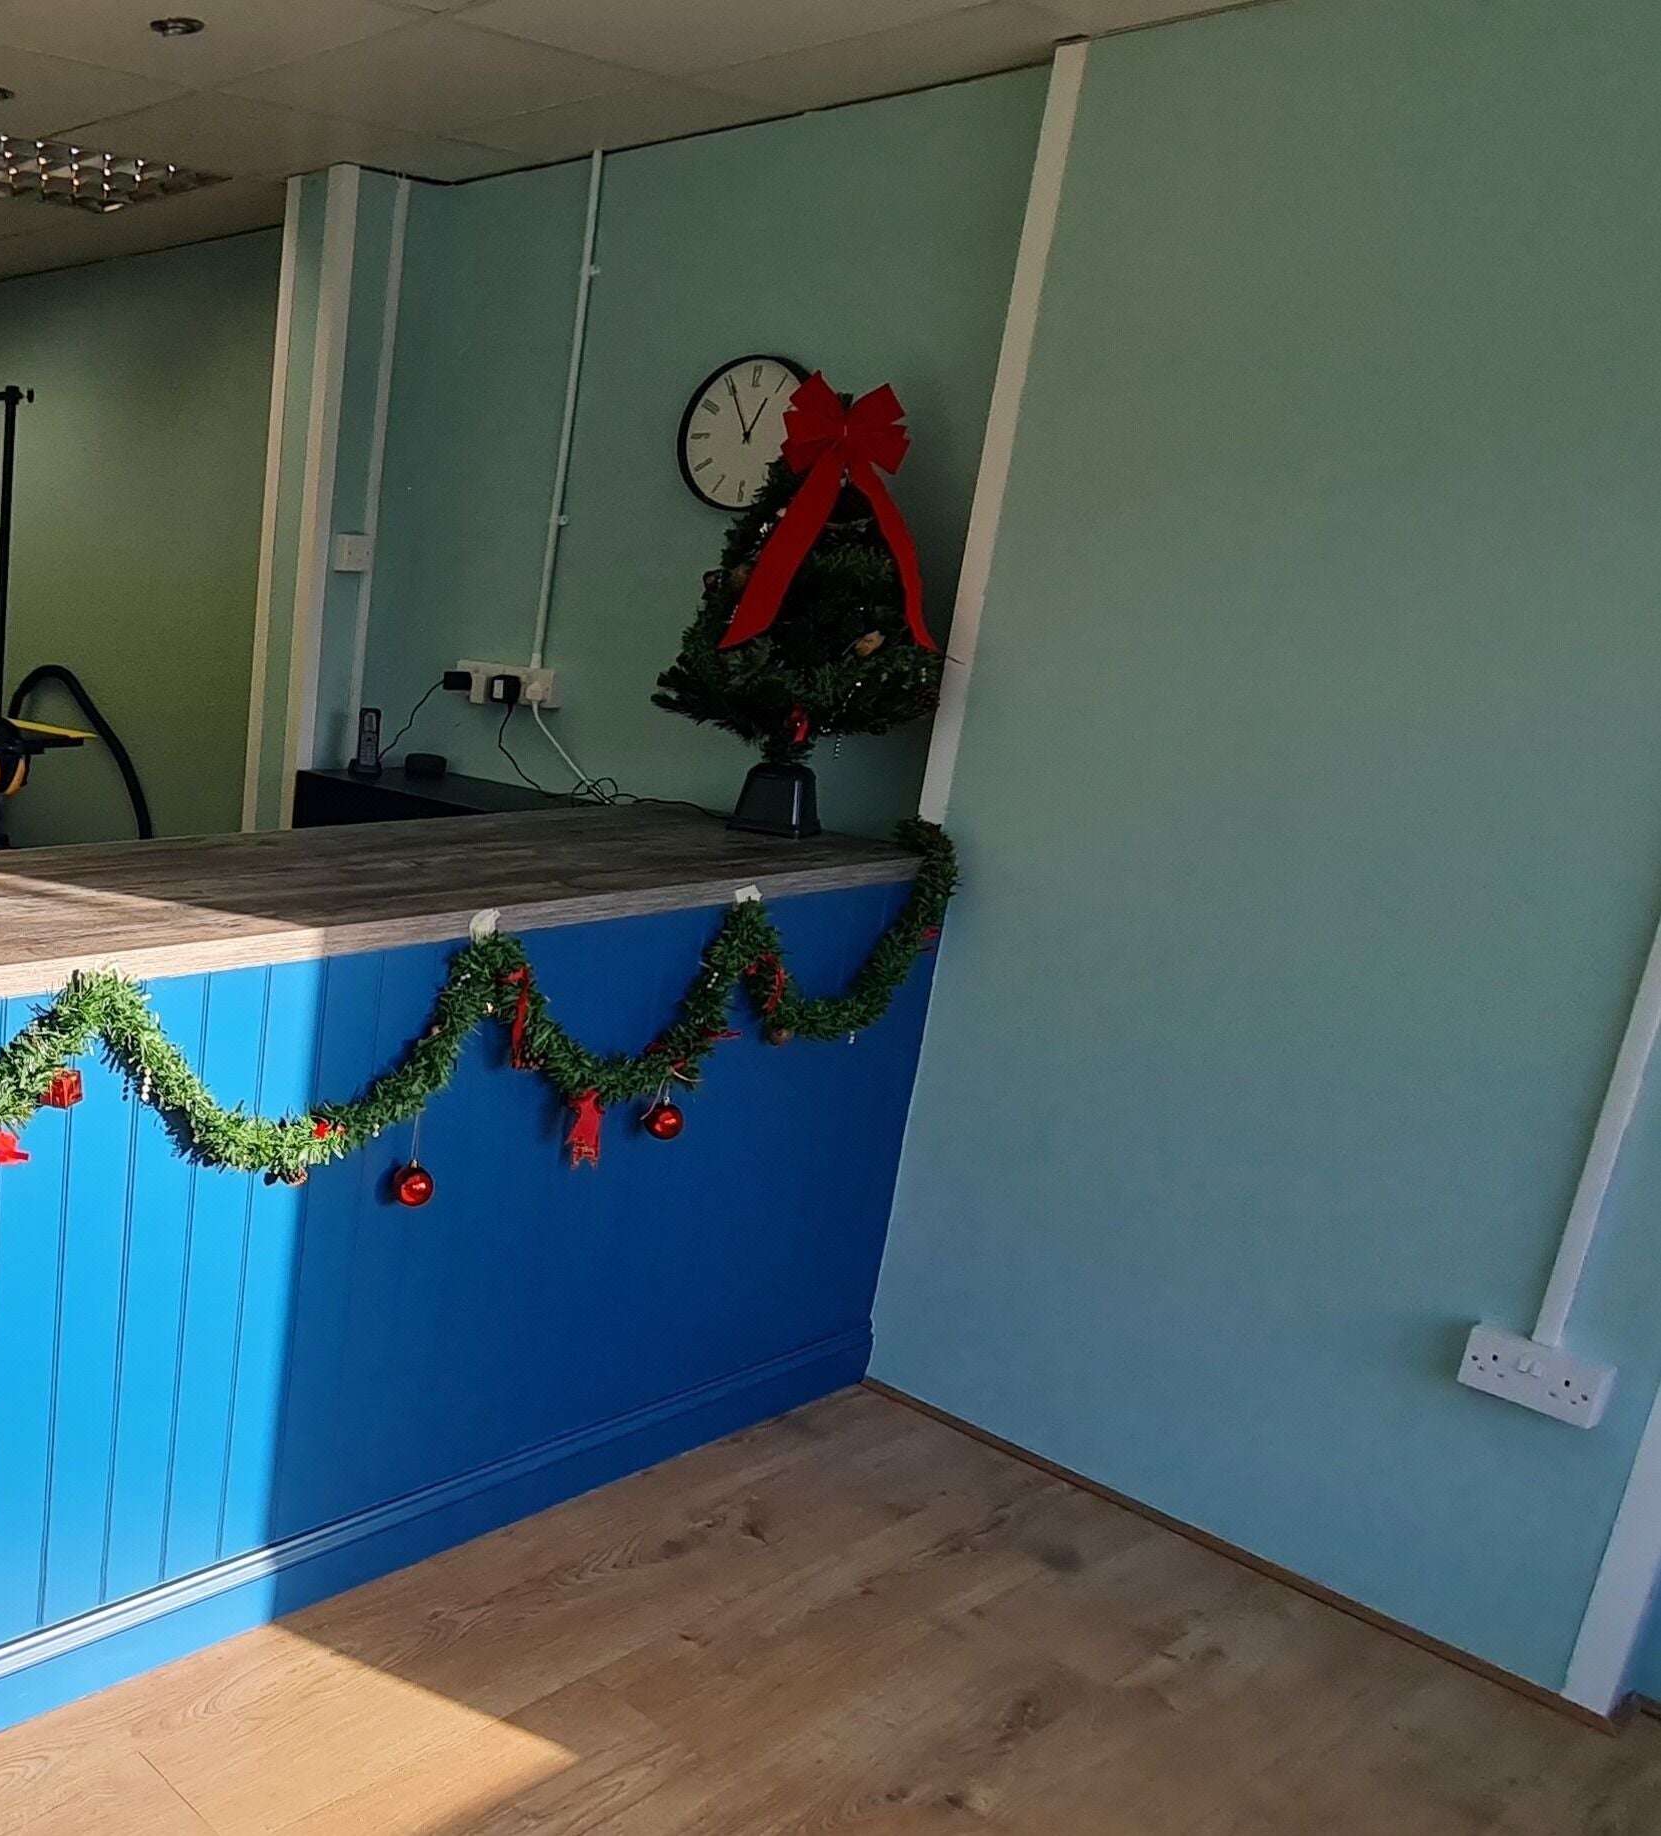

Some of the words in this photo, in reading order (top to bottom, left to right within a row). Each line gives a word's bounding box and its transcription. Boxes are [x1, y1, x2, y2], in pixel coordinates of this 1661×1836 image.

[752, 365, 764, 388] 12
[775, 373, 788, 394] 1
[701, 399, 720, 416] 10
[690, 432, 710, 440] 9
